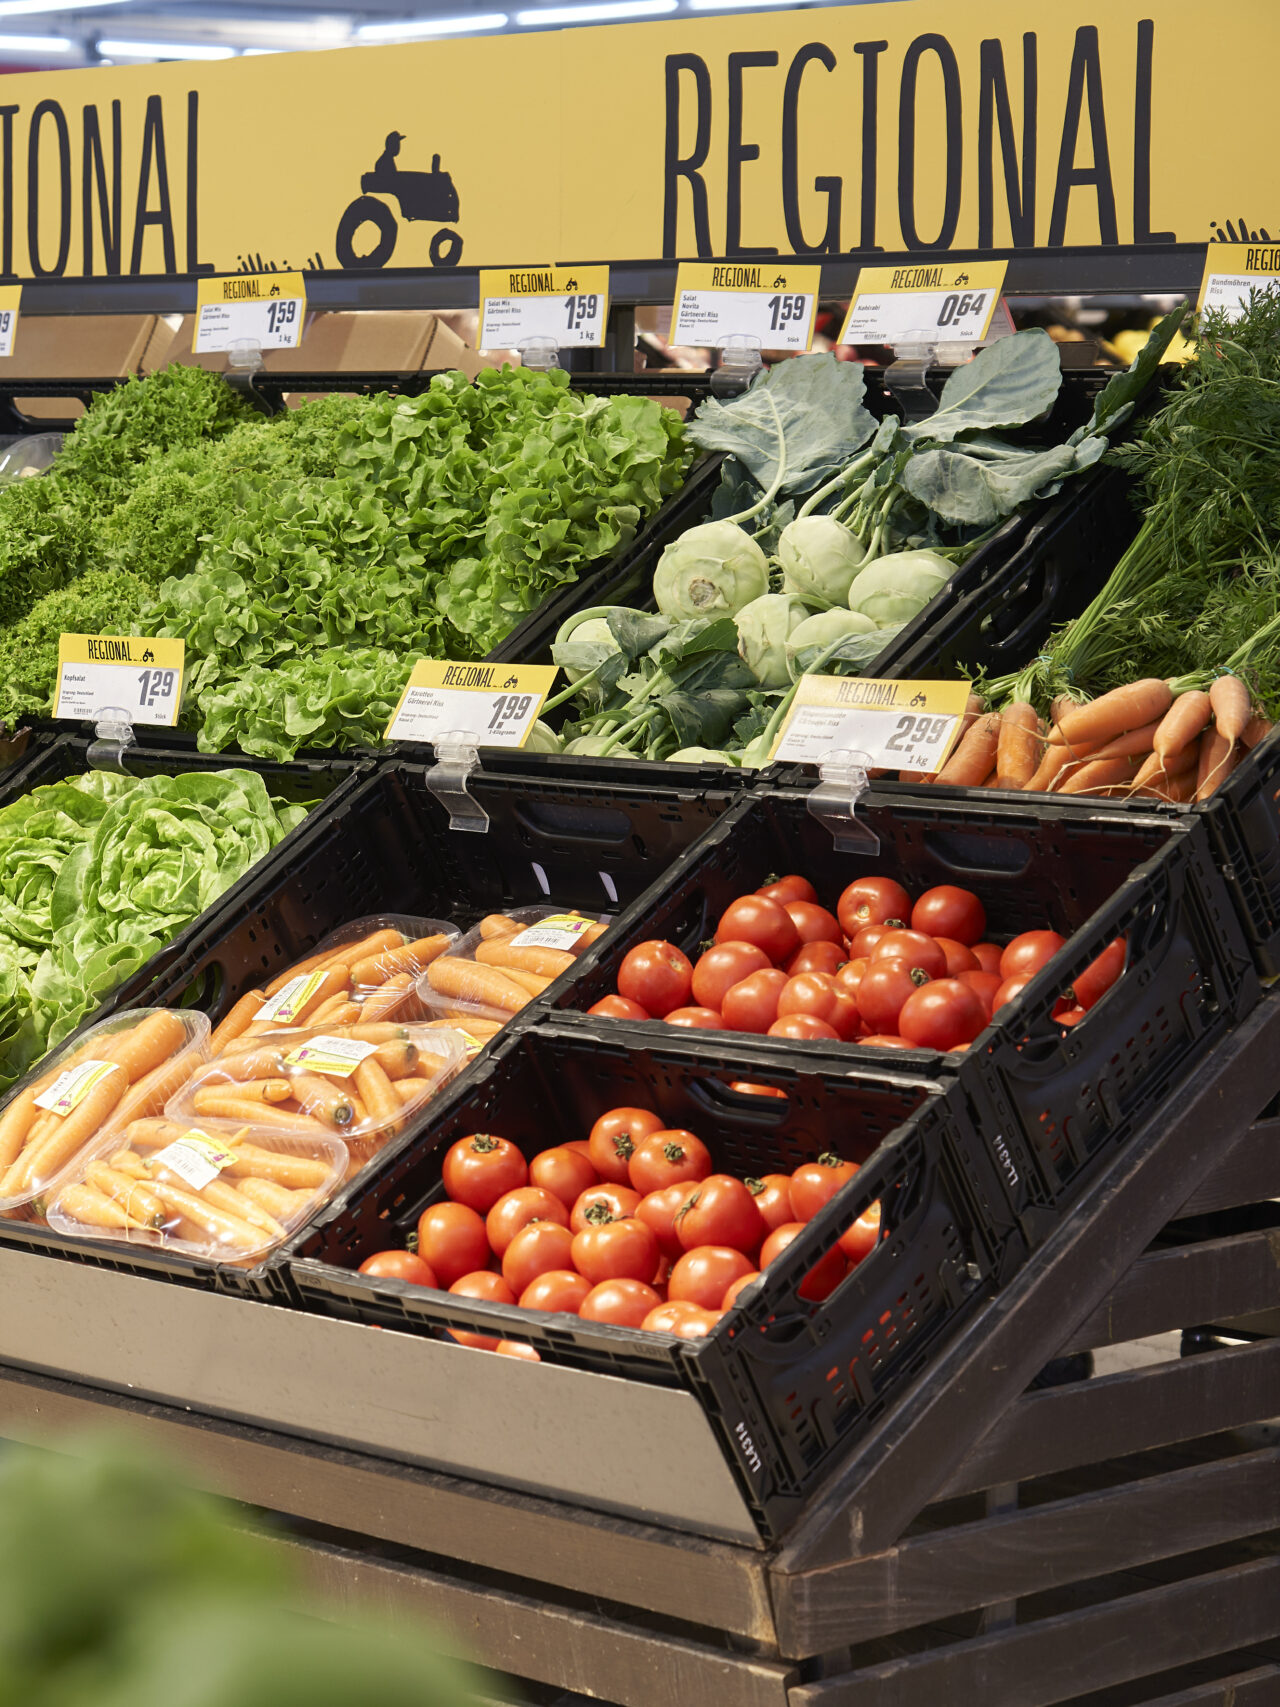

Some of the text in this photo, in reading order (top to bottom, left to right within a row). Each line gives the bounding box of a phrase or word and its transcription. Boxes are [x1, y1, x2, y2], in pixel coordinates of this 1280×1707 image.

[665, 18, 1177, 260] REGIONAL
[509, 273, 556, 293] REGIONAL
[712, 267, 762, 288] REGIONAL
[890, 268, 944, 289] REGIONAL
[1211, 278, 1251, 287] Bundmöhren
[223, 280, 261, 299] REGIONAL
[1209, 287, 1223, 295] Riss
[267, 301, 296, 333] 1.59
[564, 294, 598, 330] 1.59
[768, 295, 806, 331] 1.59
[937, 293, 987, 327] 0.64
[278, 334, 292, 343] 1 kg
[579, 330, 595, 341] 1 kg
[88, 639, 132, 662] REGIONAL
[63, 674, 86, 682] Kopfsalat
[441, 666, 496, 688] REGIONAL
[137, 670, 175, 707] 1.29
[836, 681, 899, 706] REGIONAL
[407, 698, 432, 706] Gärtnerei
[487, 695, 533, 730] 1.99
[885, 715, 948, 752] 2.99
[907, 753, 929, 766] 1 kg
[735, 1422, 762, 1473] LL4314
